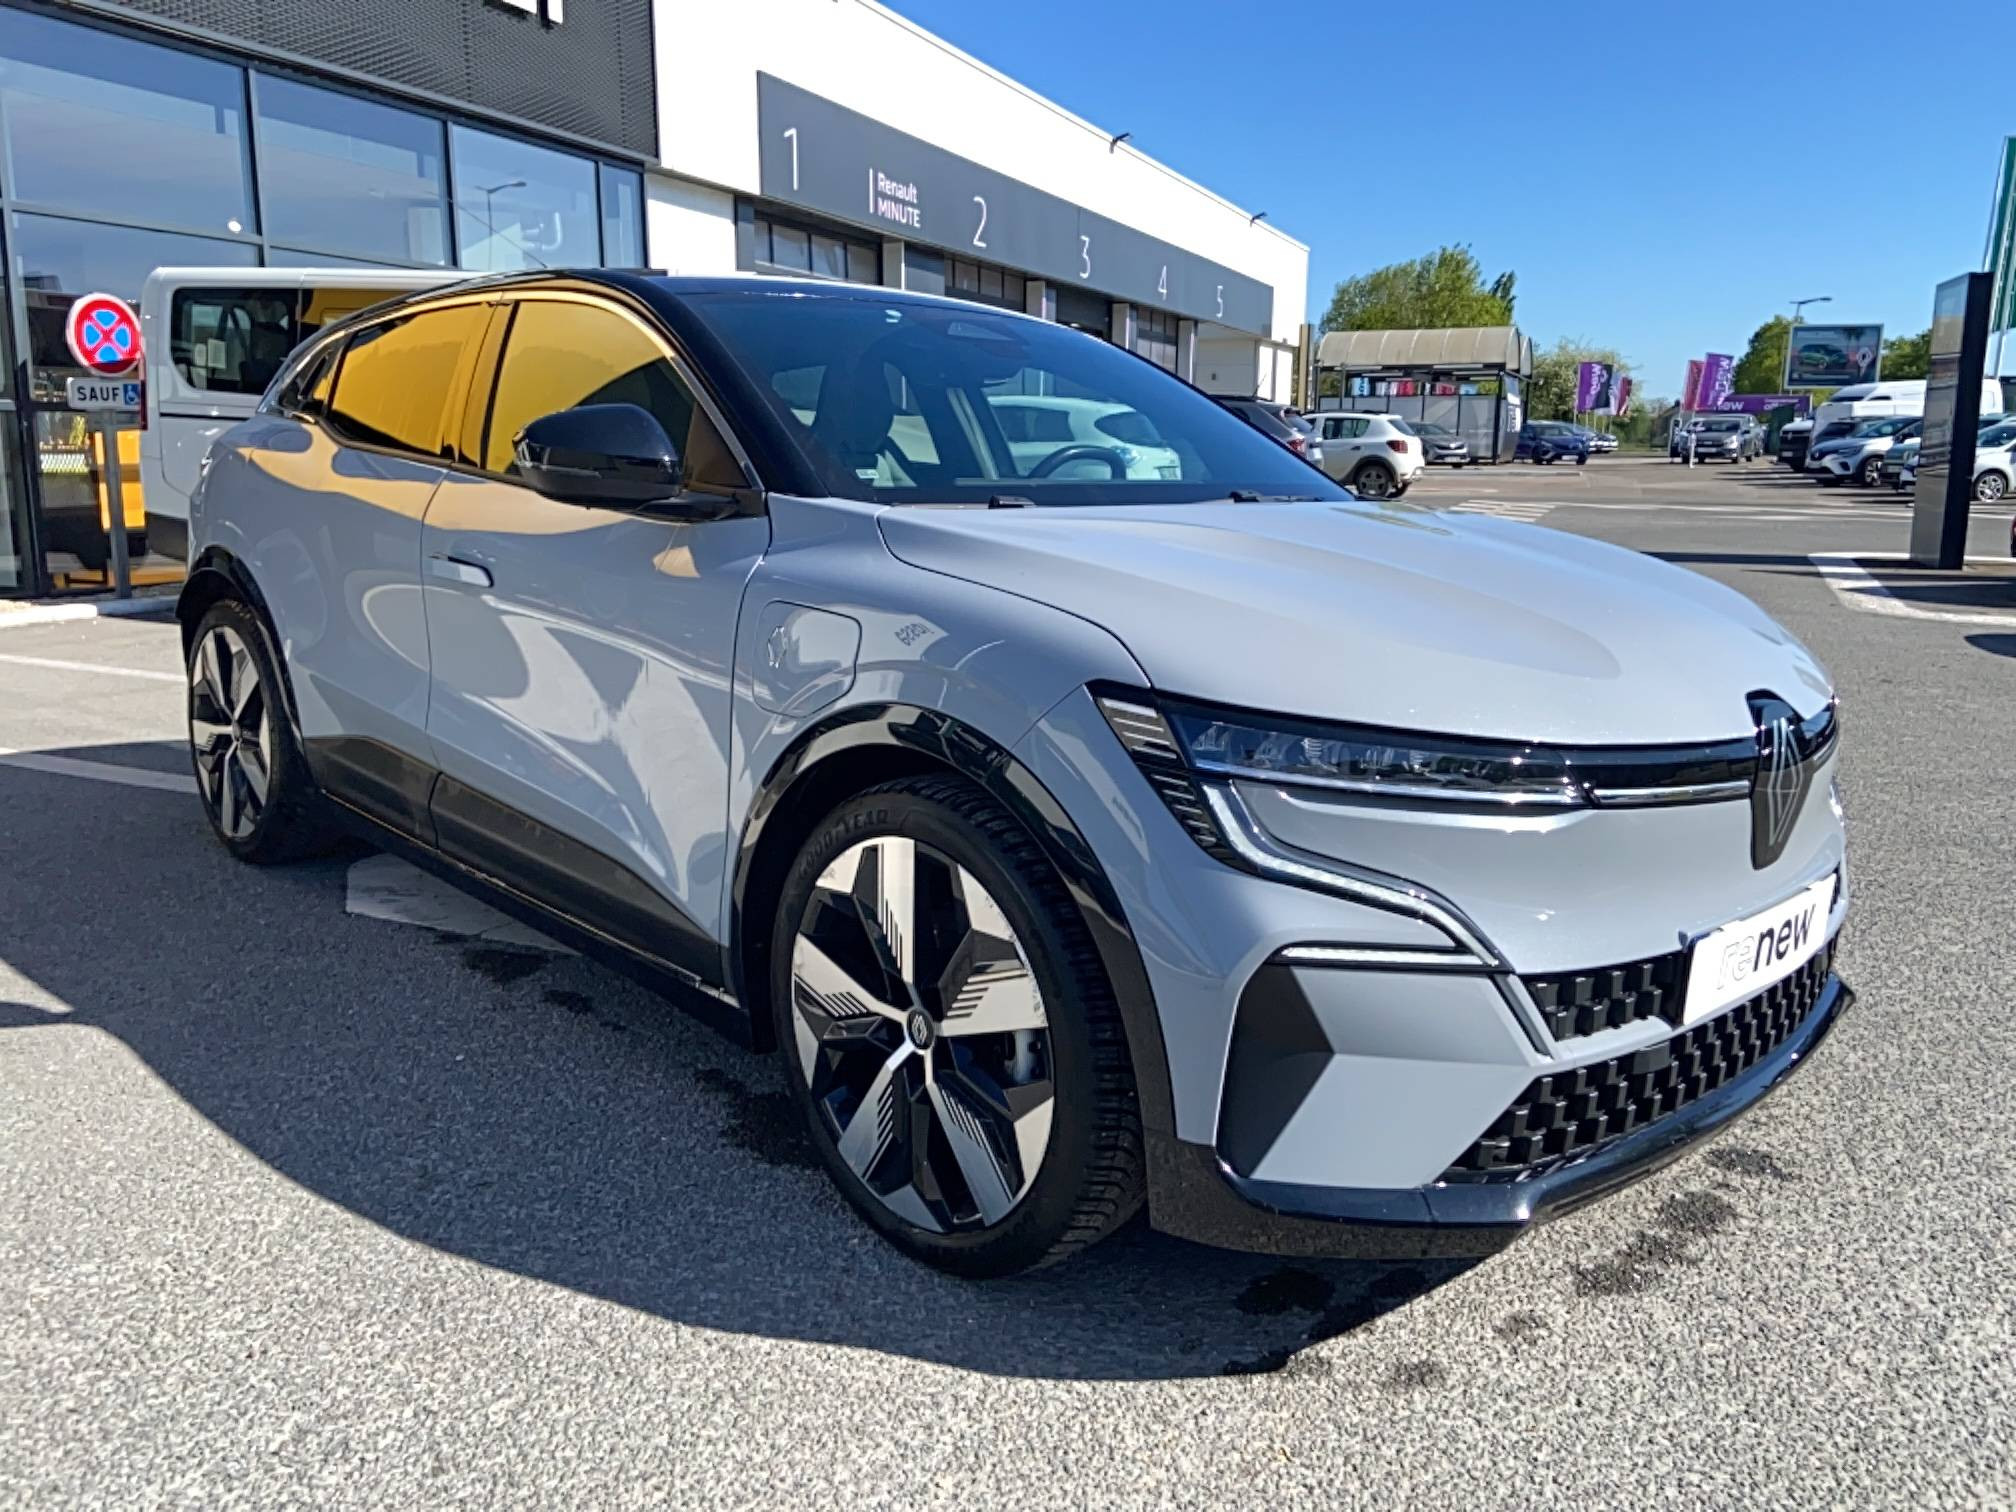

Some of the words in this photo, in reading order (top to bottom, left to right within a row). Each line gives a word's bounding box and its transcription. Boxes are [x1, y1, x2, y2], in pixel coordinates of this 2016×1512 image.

[783, 127, 798, 191] 1
[877, 172, 918, 204] Renault
[877, 197, 921, 228] MINUTE
[973, 196, 987, 248] 2
[1079, 234, 1091, 279] 3
[1157, 265, 1168, 301] 4
[1216, 285, 1224, 318] 5
[76, 386, 120, 401] SAUF
